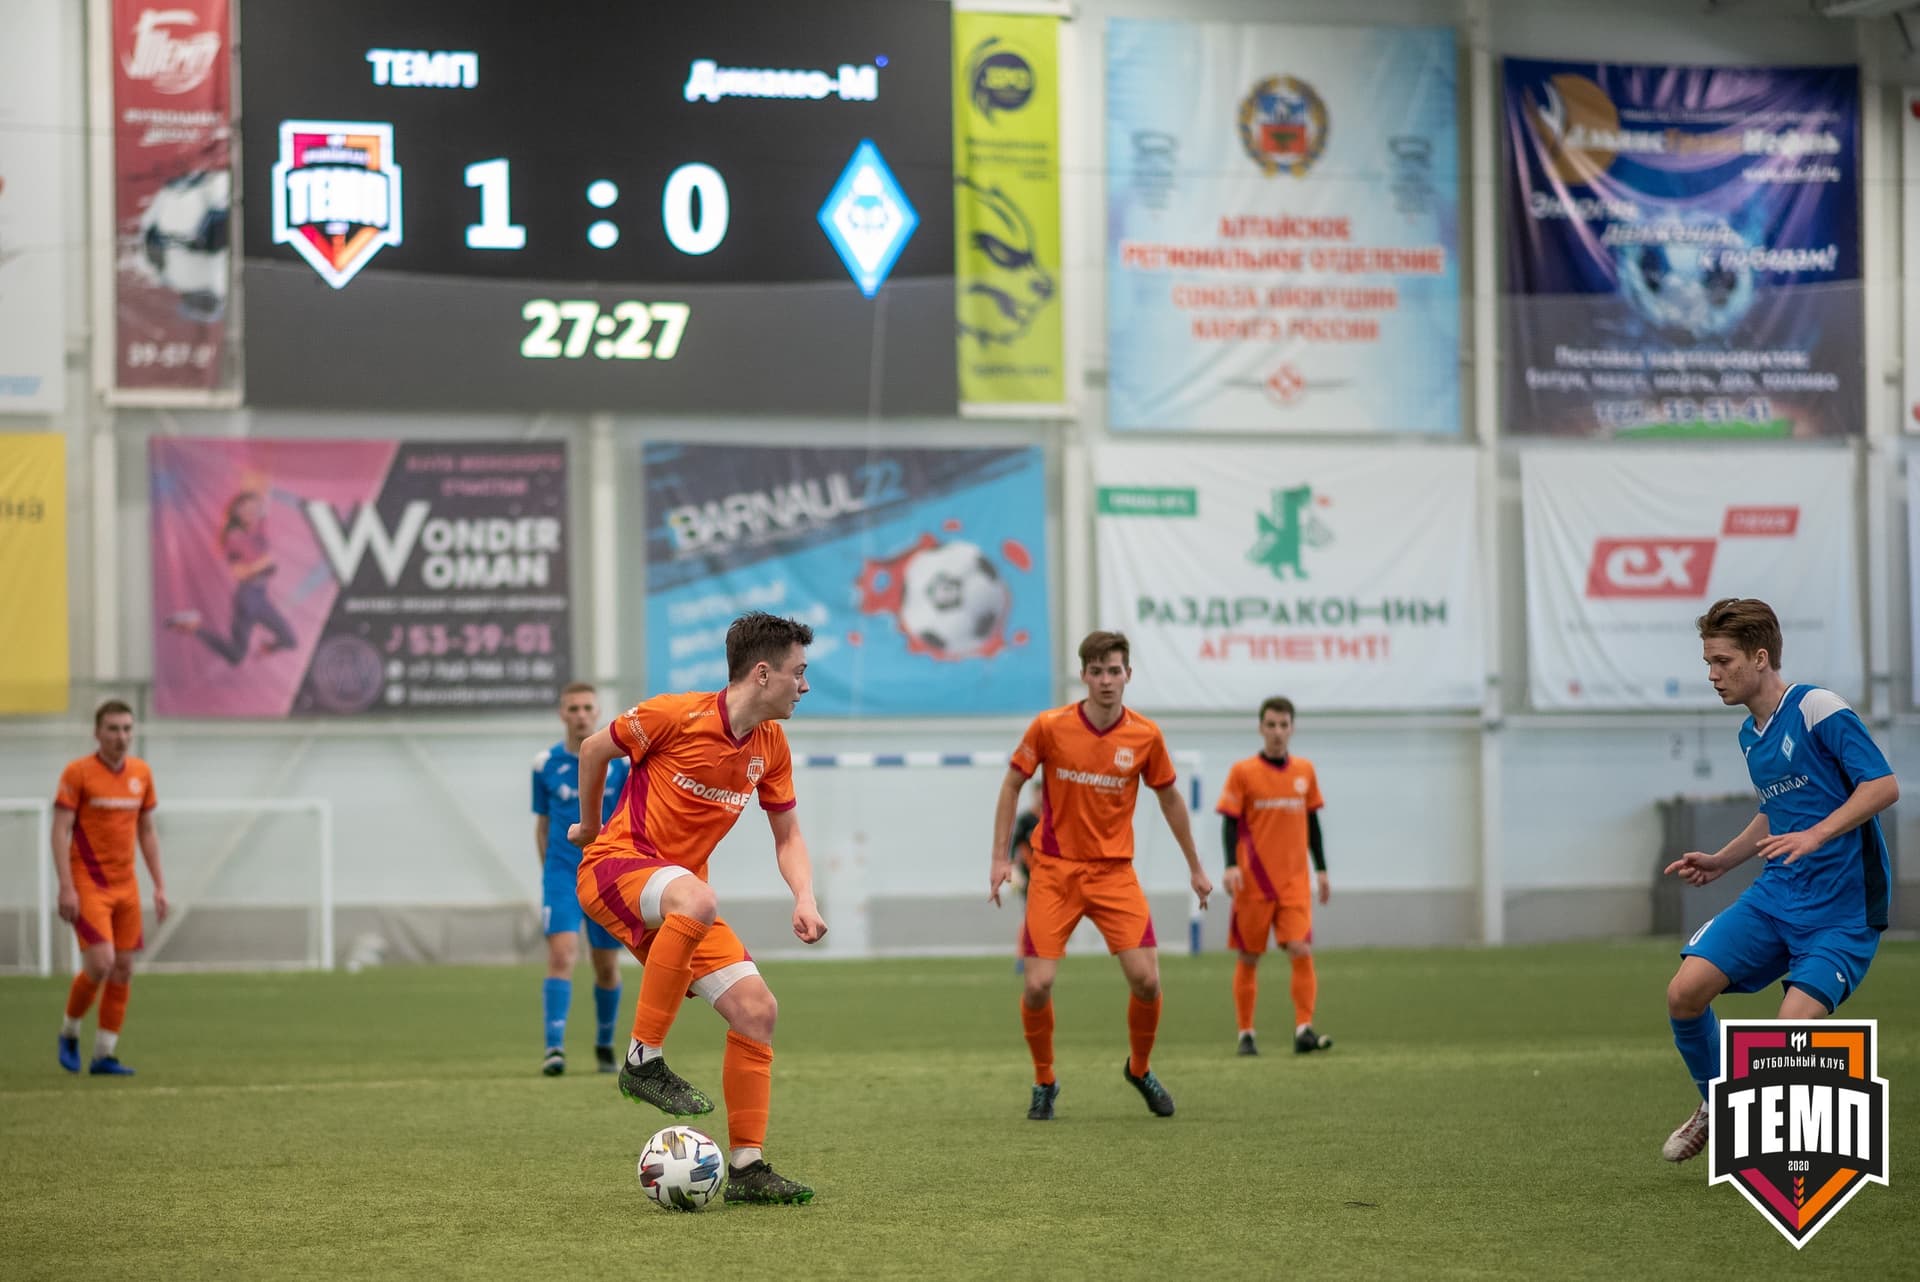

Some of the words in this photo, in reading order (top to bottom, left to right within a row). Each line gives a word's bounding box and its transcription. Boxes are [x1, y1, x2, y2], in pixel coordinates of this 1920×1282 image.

[366, 47, 480, 89] ТЕМП
[684, 58, 879, 102] Динамо-М
[465, 158, 526, 250] 1
[662, 162, 730, 256] 0
[1122, 243, 1303, 272] РЕГИОНАЛЬНОЕ
[1309, 246, 1445, 274] ОТДЕЛЕНИЕ
[521, 299, 690, 361] 27:27
[671, 473, 864, 557] BARNAUL
[1136, 597, 1448, 628] РАЗДРАКОНИМ
[1199, 634, 1390, 662] АППЕТИТ!
